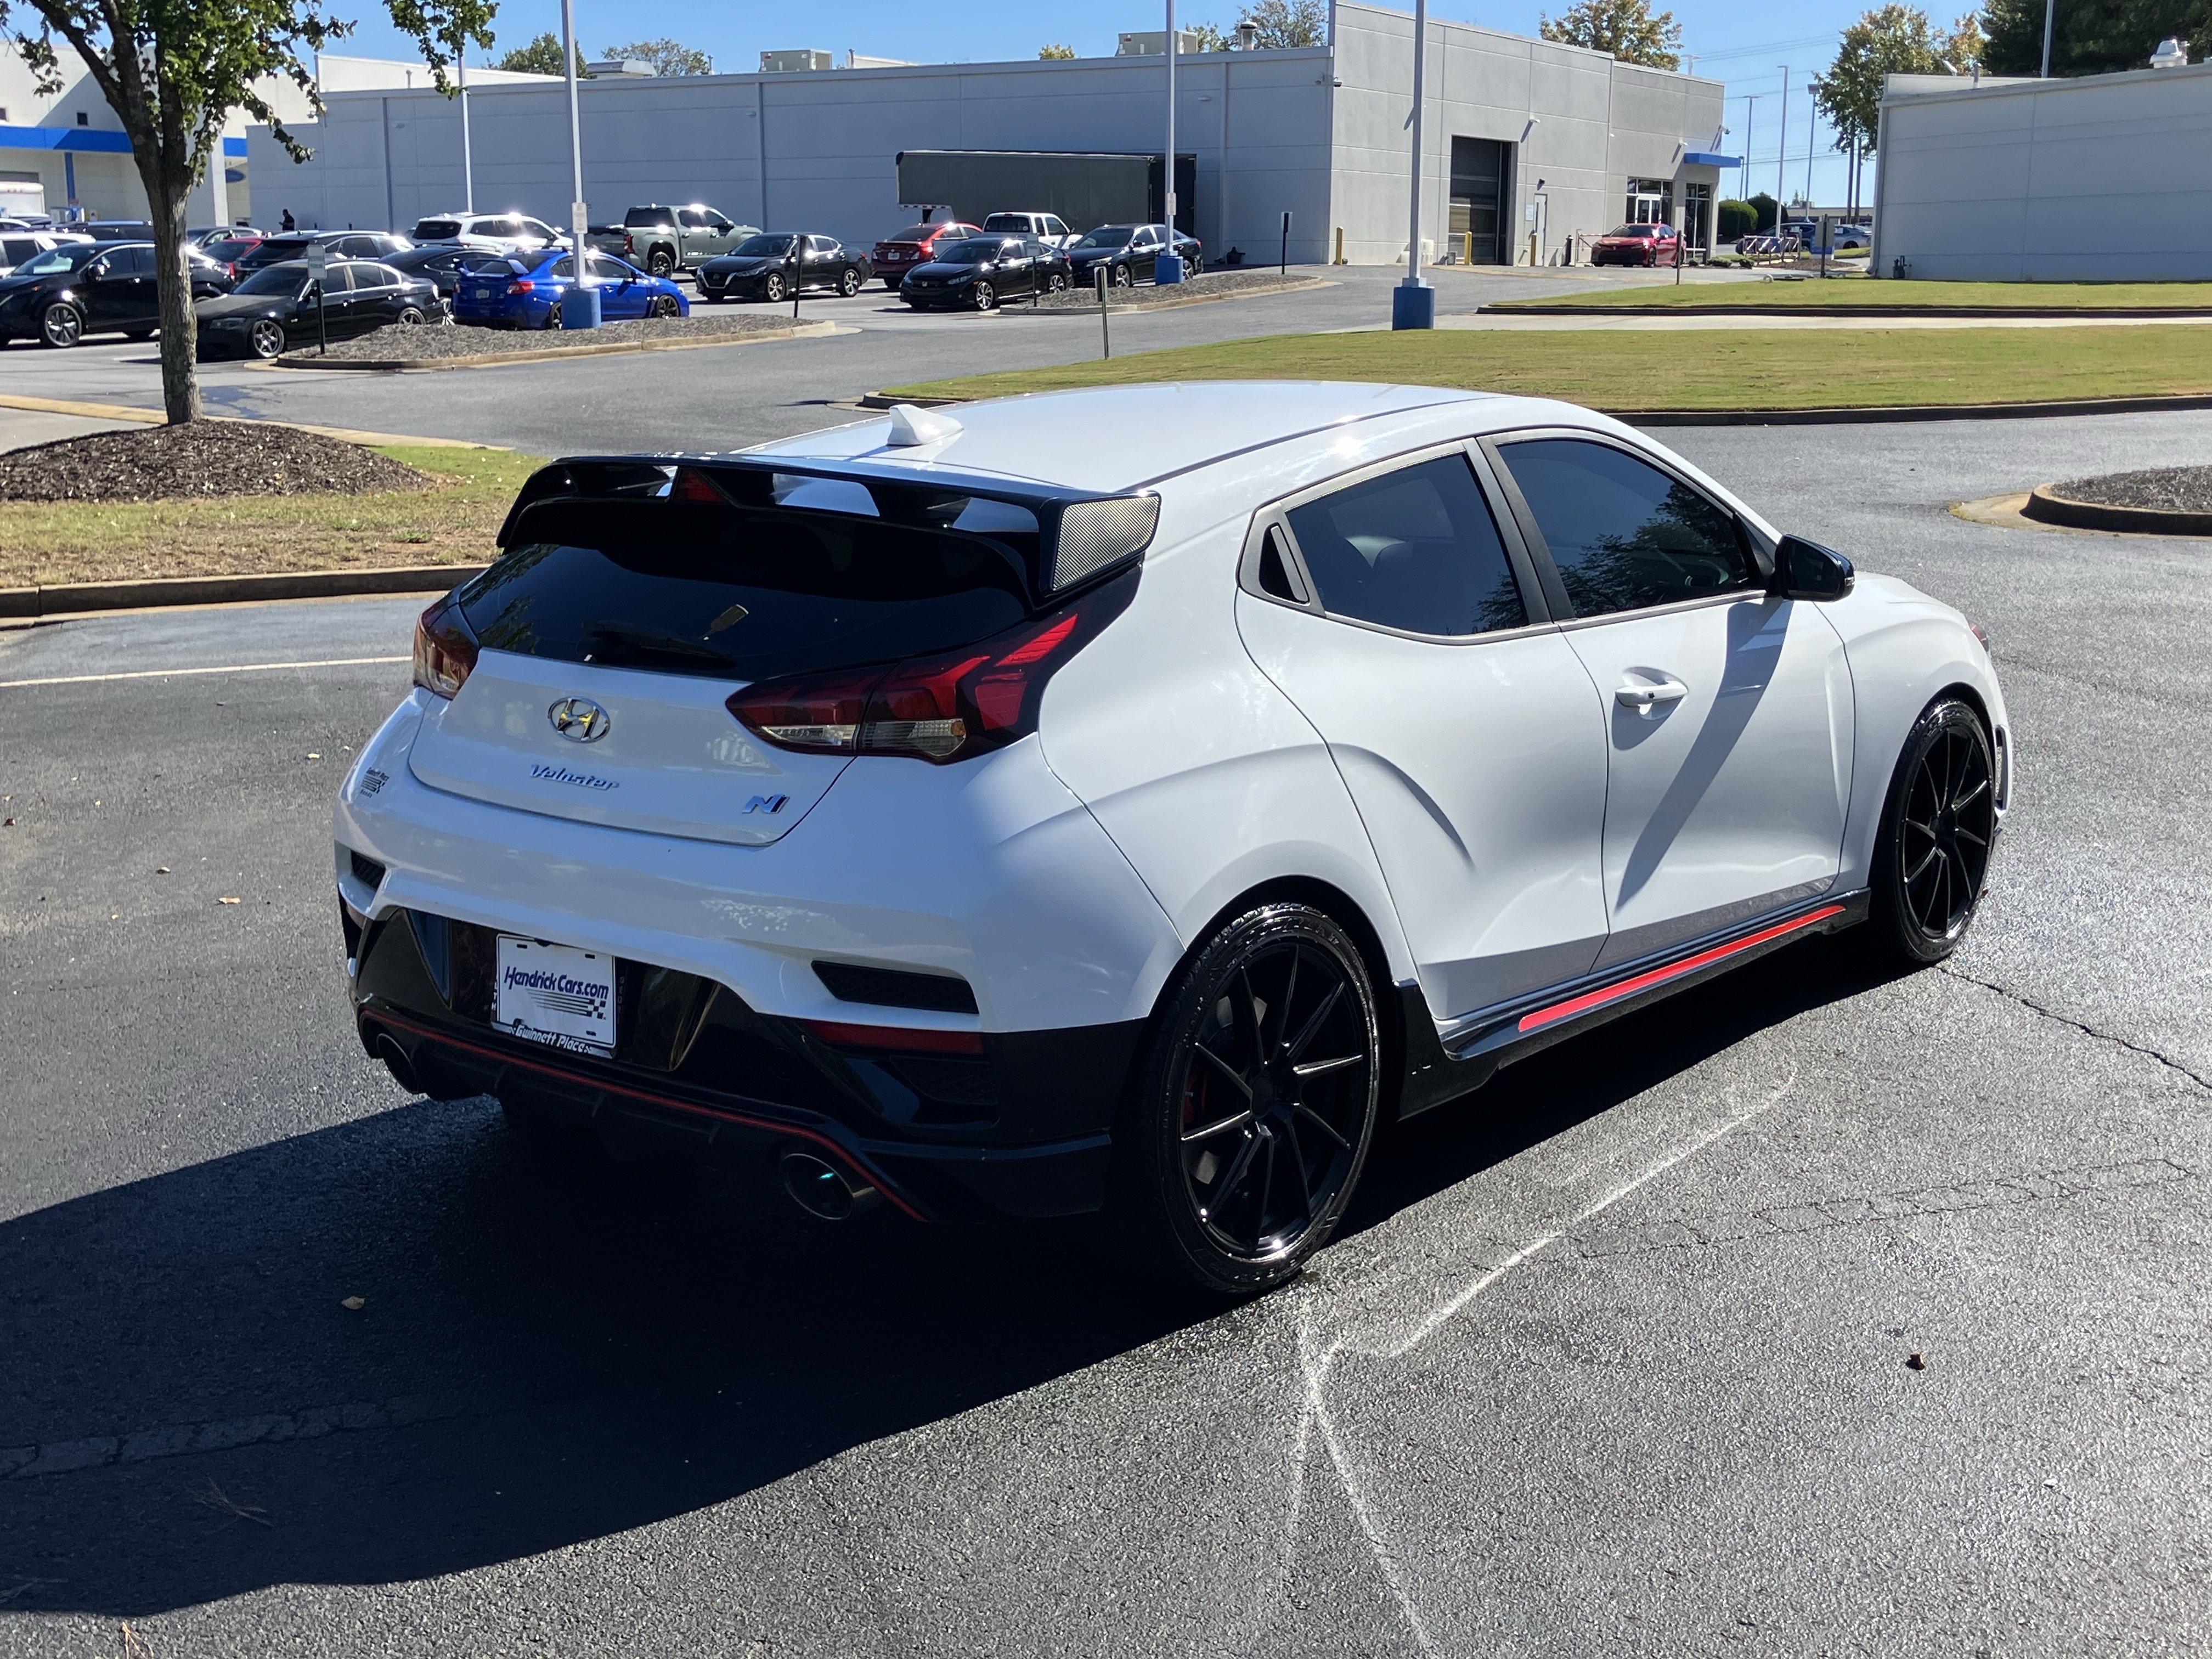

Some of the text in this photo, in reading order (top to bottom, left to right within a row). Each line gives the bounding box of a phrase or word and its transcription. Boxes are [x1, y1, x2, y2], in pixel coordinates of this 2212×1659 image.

[531, 764, 620, 791] Veloster
[516, 1024, 586, 1053] Gwinnett Place
